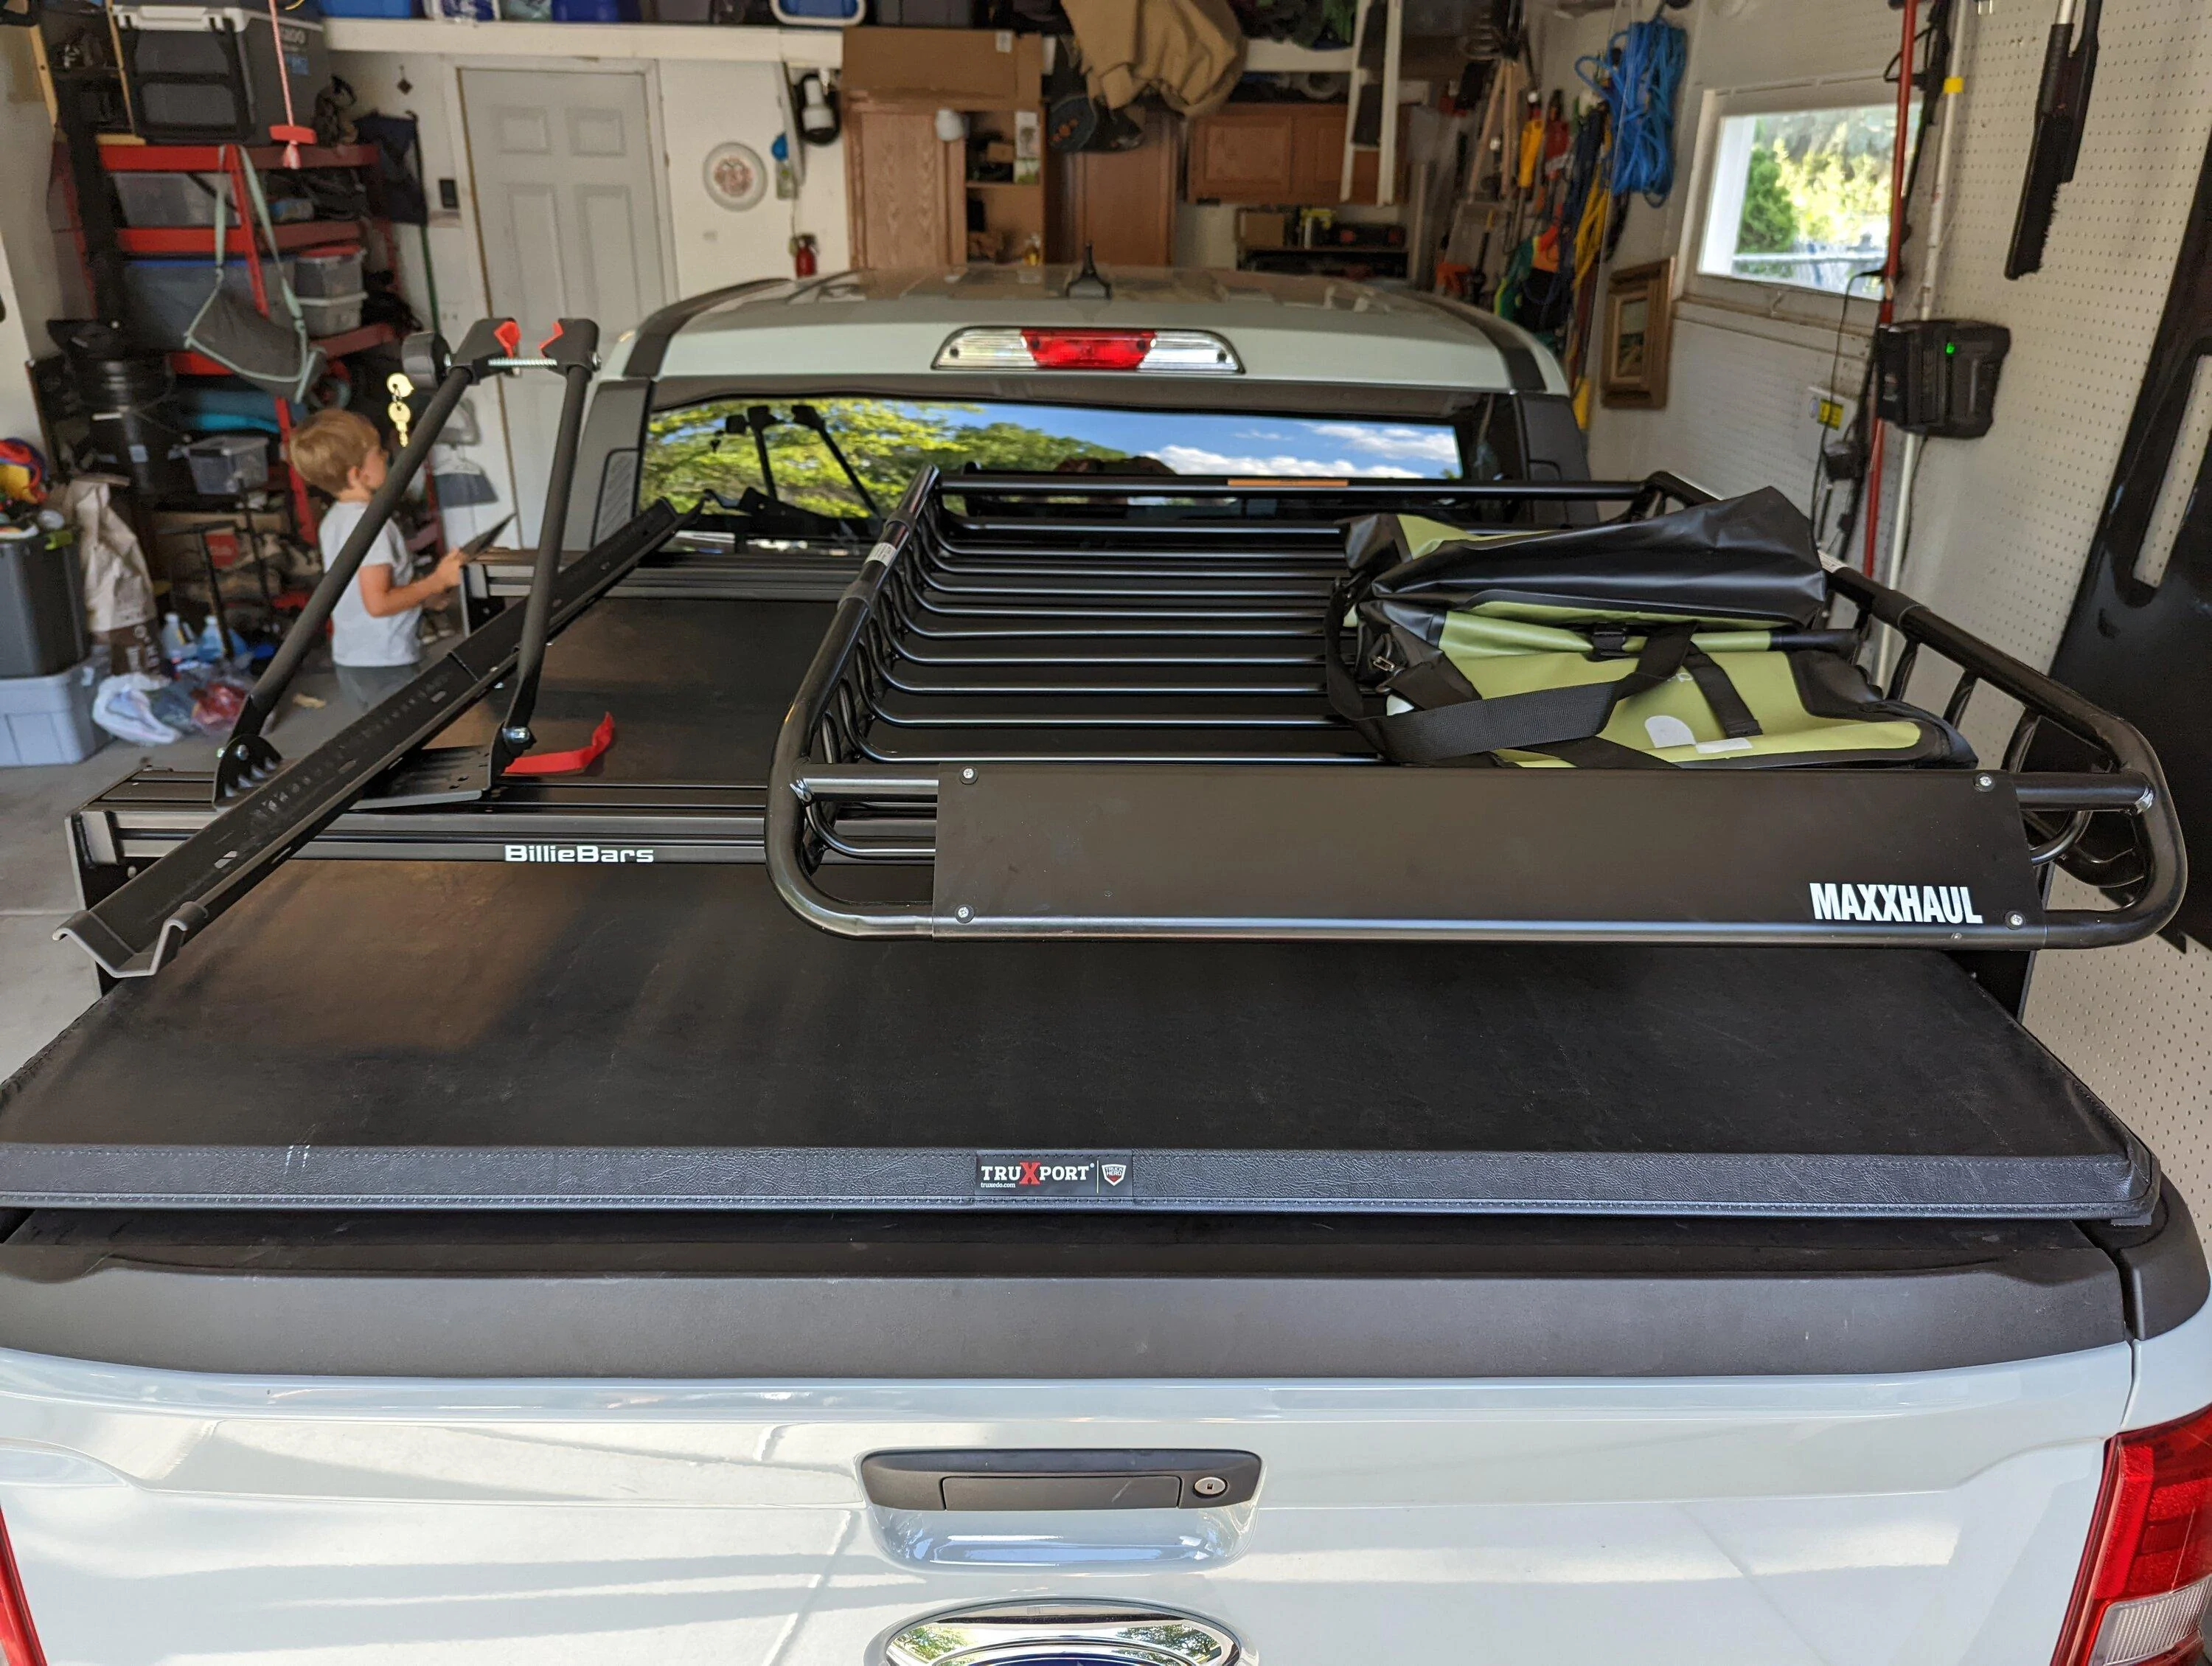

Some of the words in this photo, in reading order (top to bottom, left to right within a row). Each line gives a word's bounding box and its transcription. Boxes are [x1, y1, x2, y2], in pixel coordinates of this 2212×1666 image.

[505, 844, 654, 863] BillieBars
[1809, 883, 1983, 923] MAXXHAUL
[981, 1162, 1089, 1185] TRUXPORT
